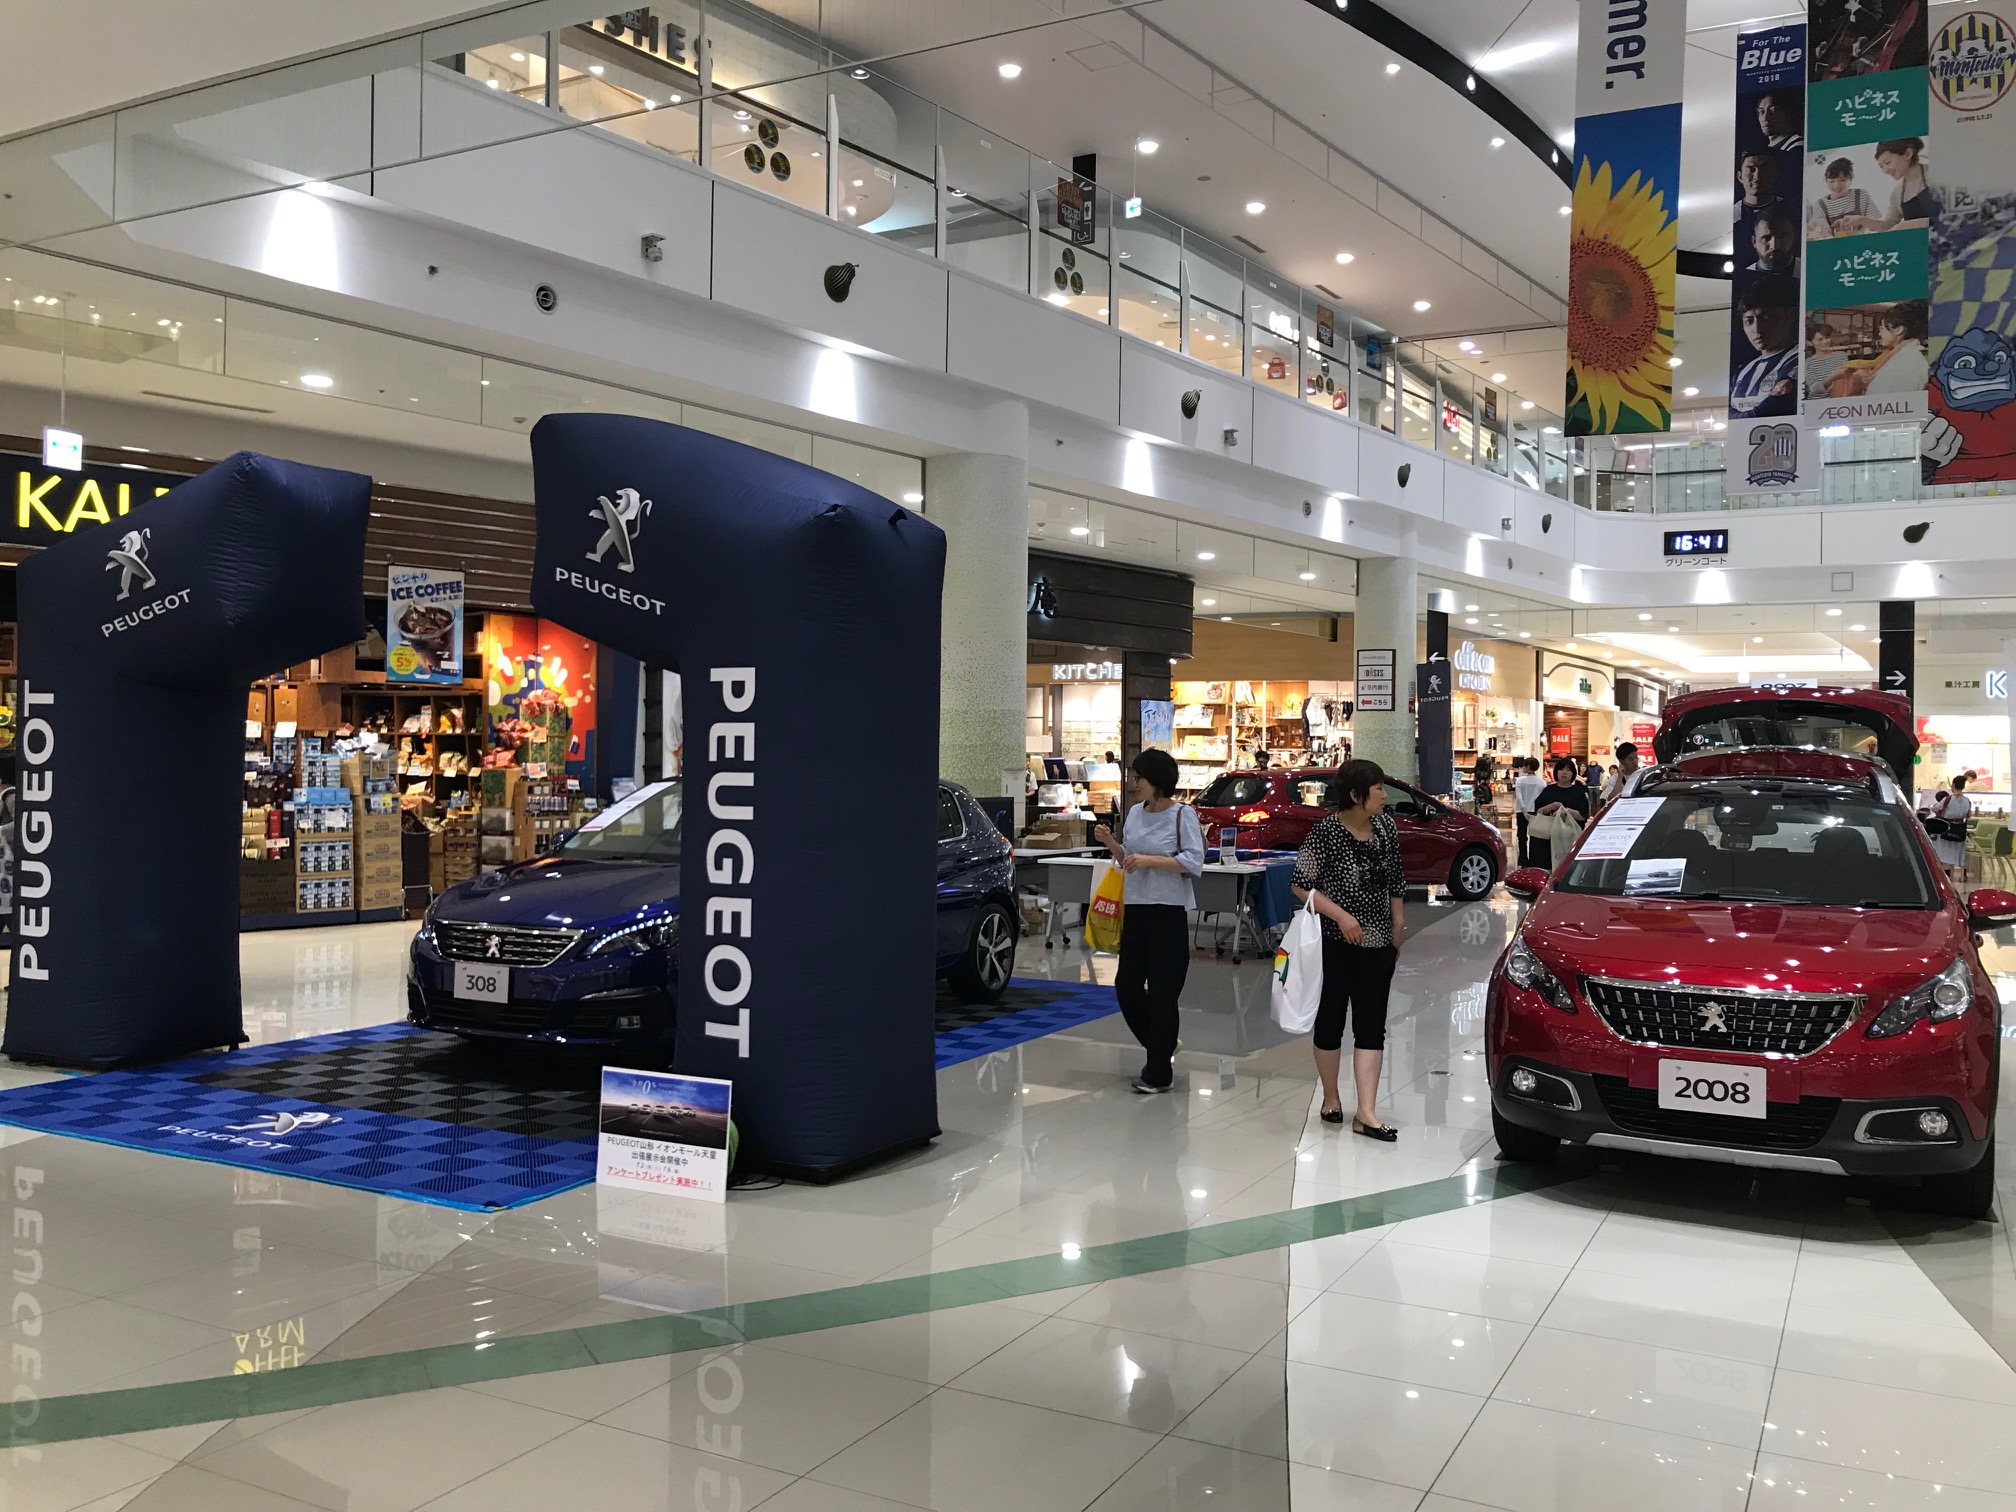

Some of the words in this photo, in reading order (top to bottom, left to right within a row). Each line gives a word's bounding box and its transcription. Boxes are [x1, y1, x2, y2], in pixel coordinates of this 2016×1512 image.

[1752, 39, 1769, 48] For
[1773, 36, 1791, 45] The
[1741, 48, 1802, 70] Blue
[1758, 74, 1780, 83] 2018
[1867, 401, 1914, 417] MALL
[1674, 534, 1724, 551] 16:41
[1665, 557, 1727, 567] グリーンコート
[391, 586, 413, 601] ICE
[414, 581, 463, 598] COFFEE
[555, 566, 666, 616] PEUGEOT
[101, 588, 192, 638] PEUGEOT
[1552, 734, 1570, 743] SALE
[19, 679, 55, 981] PEUGEOT
[704, 666, 756, 1058] PEUGEOT
[465, 974, 497, 993] 308
[1674, 1076, 1751, 1104] 2008
[157, 1125, 292, 1150] PEUGEOT
